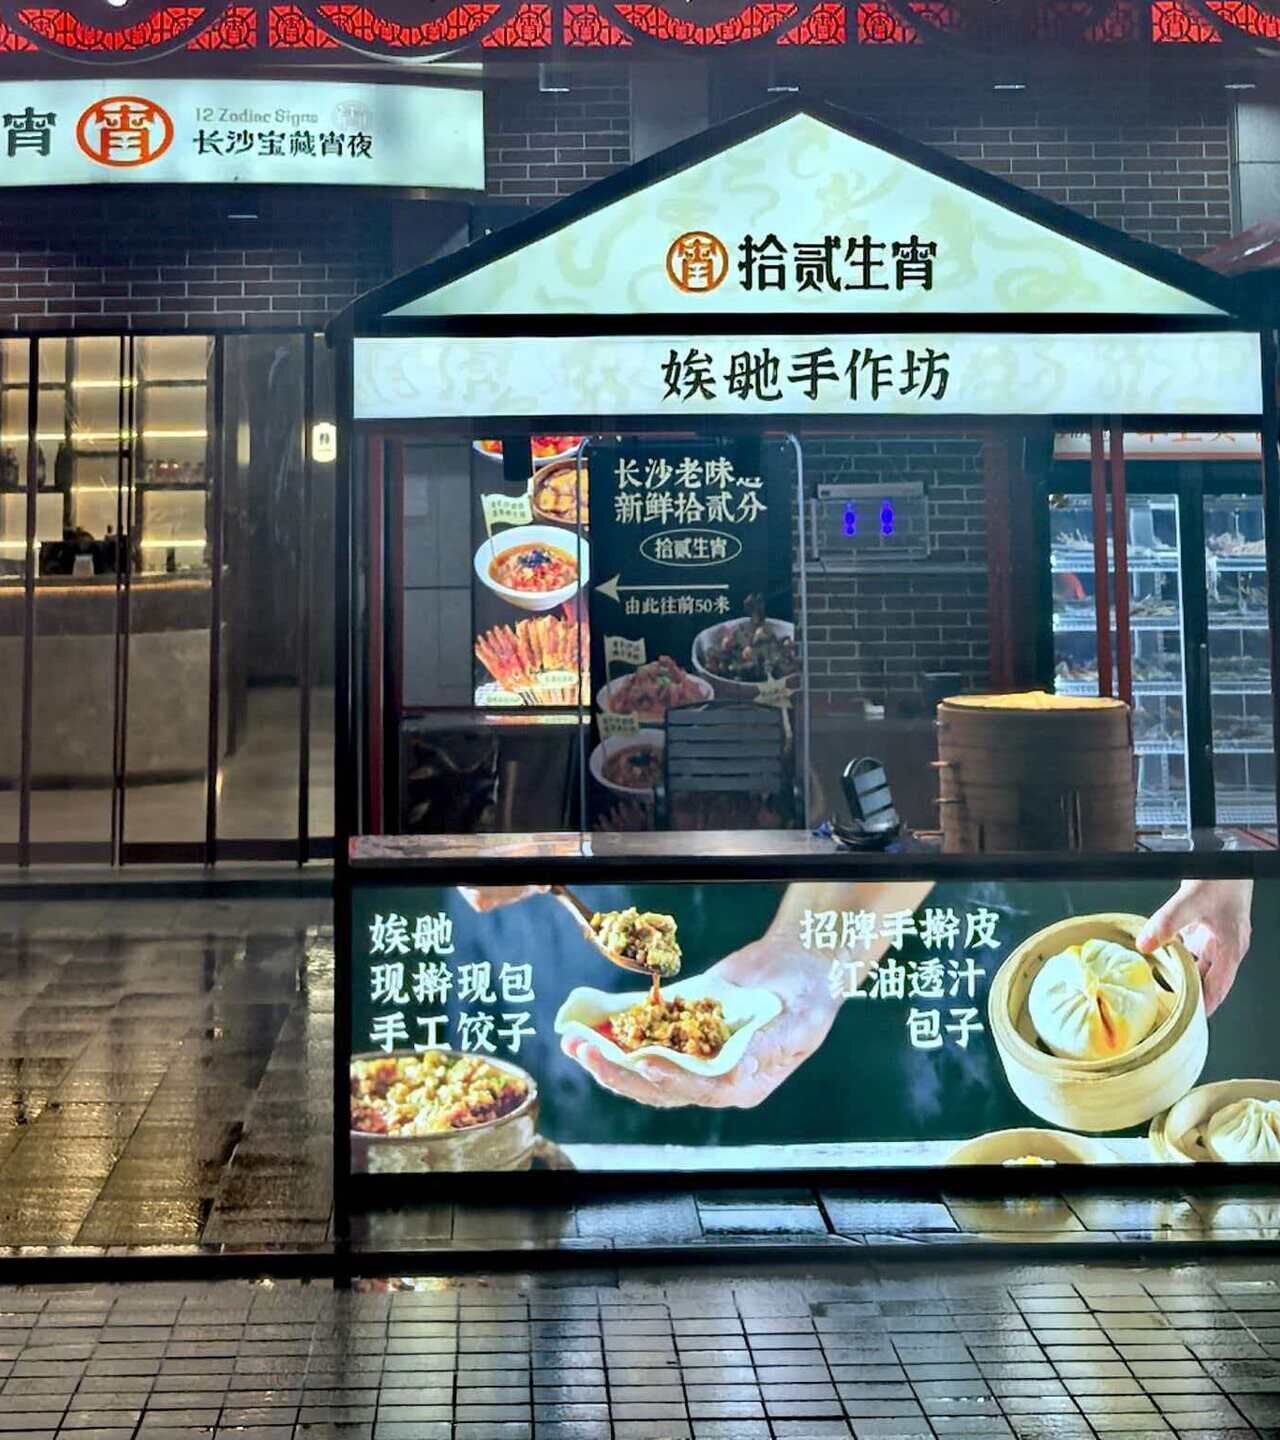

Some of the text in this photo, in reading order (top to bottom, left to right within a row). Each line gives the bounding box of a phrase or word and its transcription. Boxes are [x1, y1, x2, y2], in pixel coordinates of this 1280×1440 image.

[192, 128, 374, 159] 长沙宝藏宵夜
[738, 234, 938, 292] 拾贰生宵
[661, 347, 951, 403] 娭毑手作坊
[613, 456, 764, 489] 长沙老味
[614, 491, 768, 525] 新鲜拾贰分
[624, 595, 731, 616] 由此往前50米
[369, 911, 456, 955] 娭毑
[800, 907, 1003, 951] 招牌手擀皮
[369, 961, 536, 1005] 现擀现包
[827, 957, 986, 1001] 红油透汁
[369, 1011, 536, 1054] 手工饺子
[906, 1007, 985, 1049] 包子
